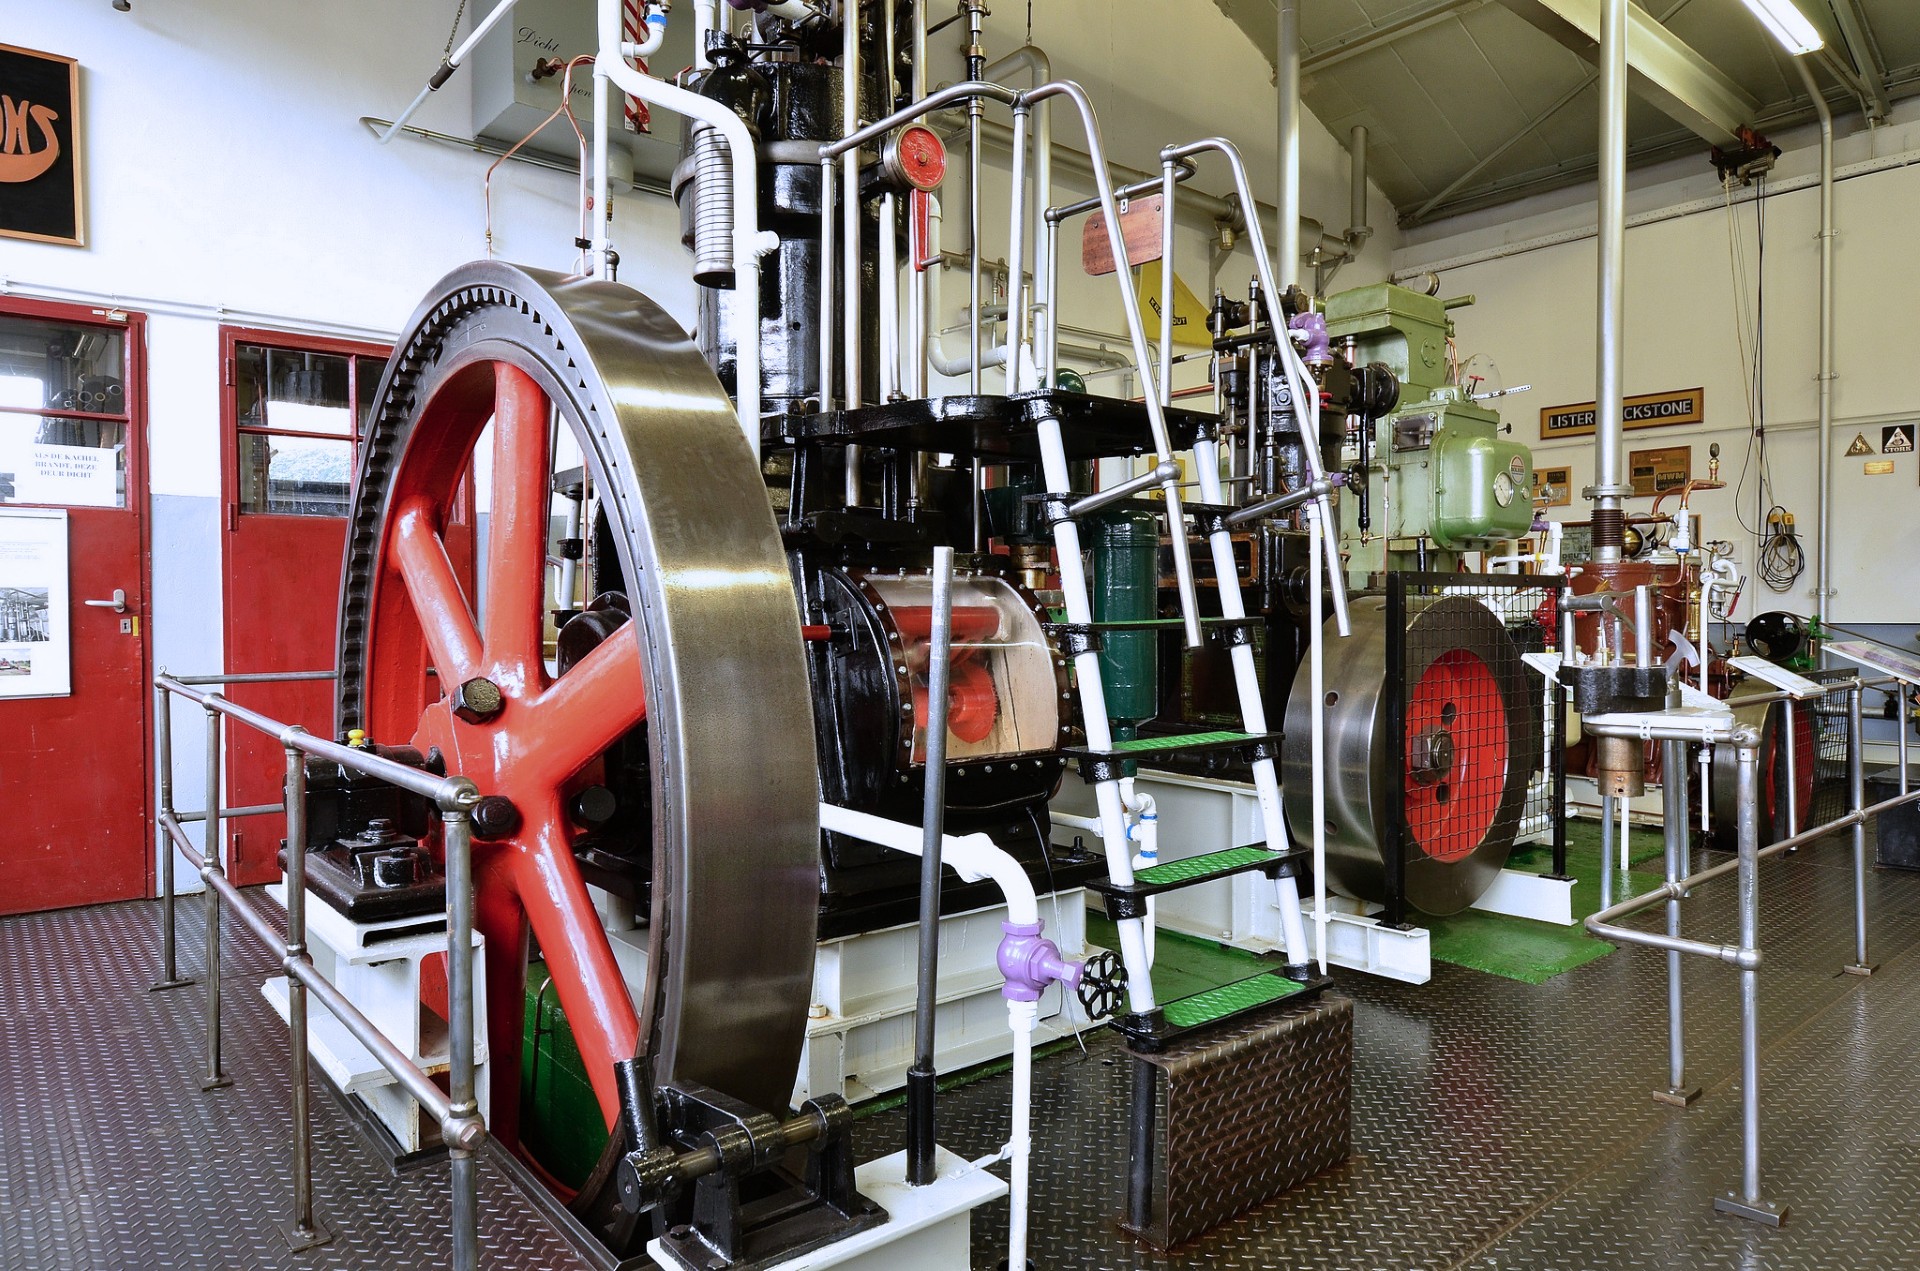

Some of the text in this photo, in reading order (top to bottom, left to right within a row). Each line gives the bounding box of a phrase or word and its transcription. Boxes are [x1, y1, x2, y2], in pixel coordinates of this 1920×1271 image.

[517, 26, 560, 53] Dicht
[1149, 297, 1187, 326] KROOUT
[1550, 399, 1692, 428] LISTER CKSTONE
[40, 469, 92, 479] DEUR DICHT
